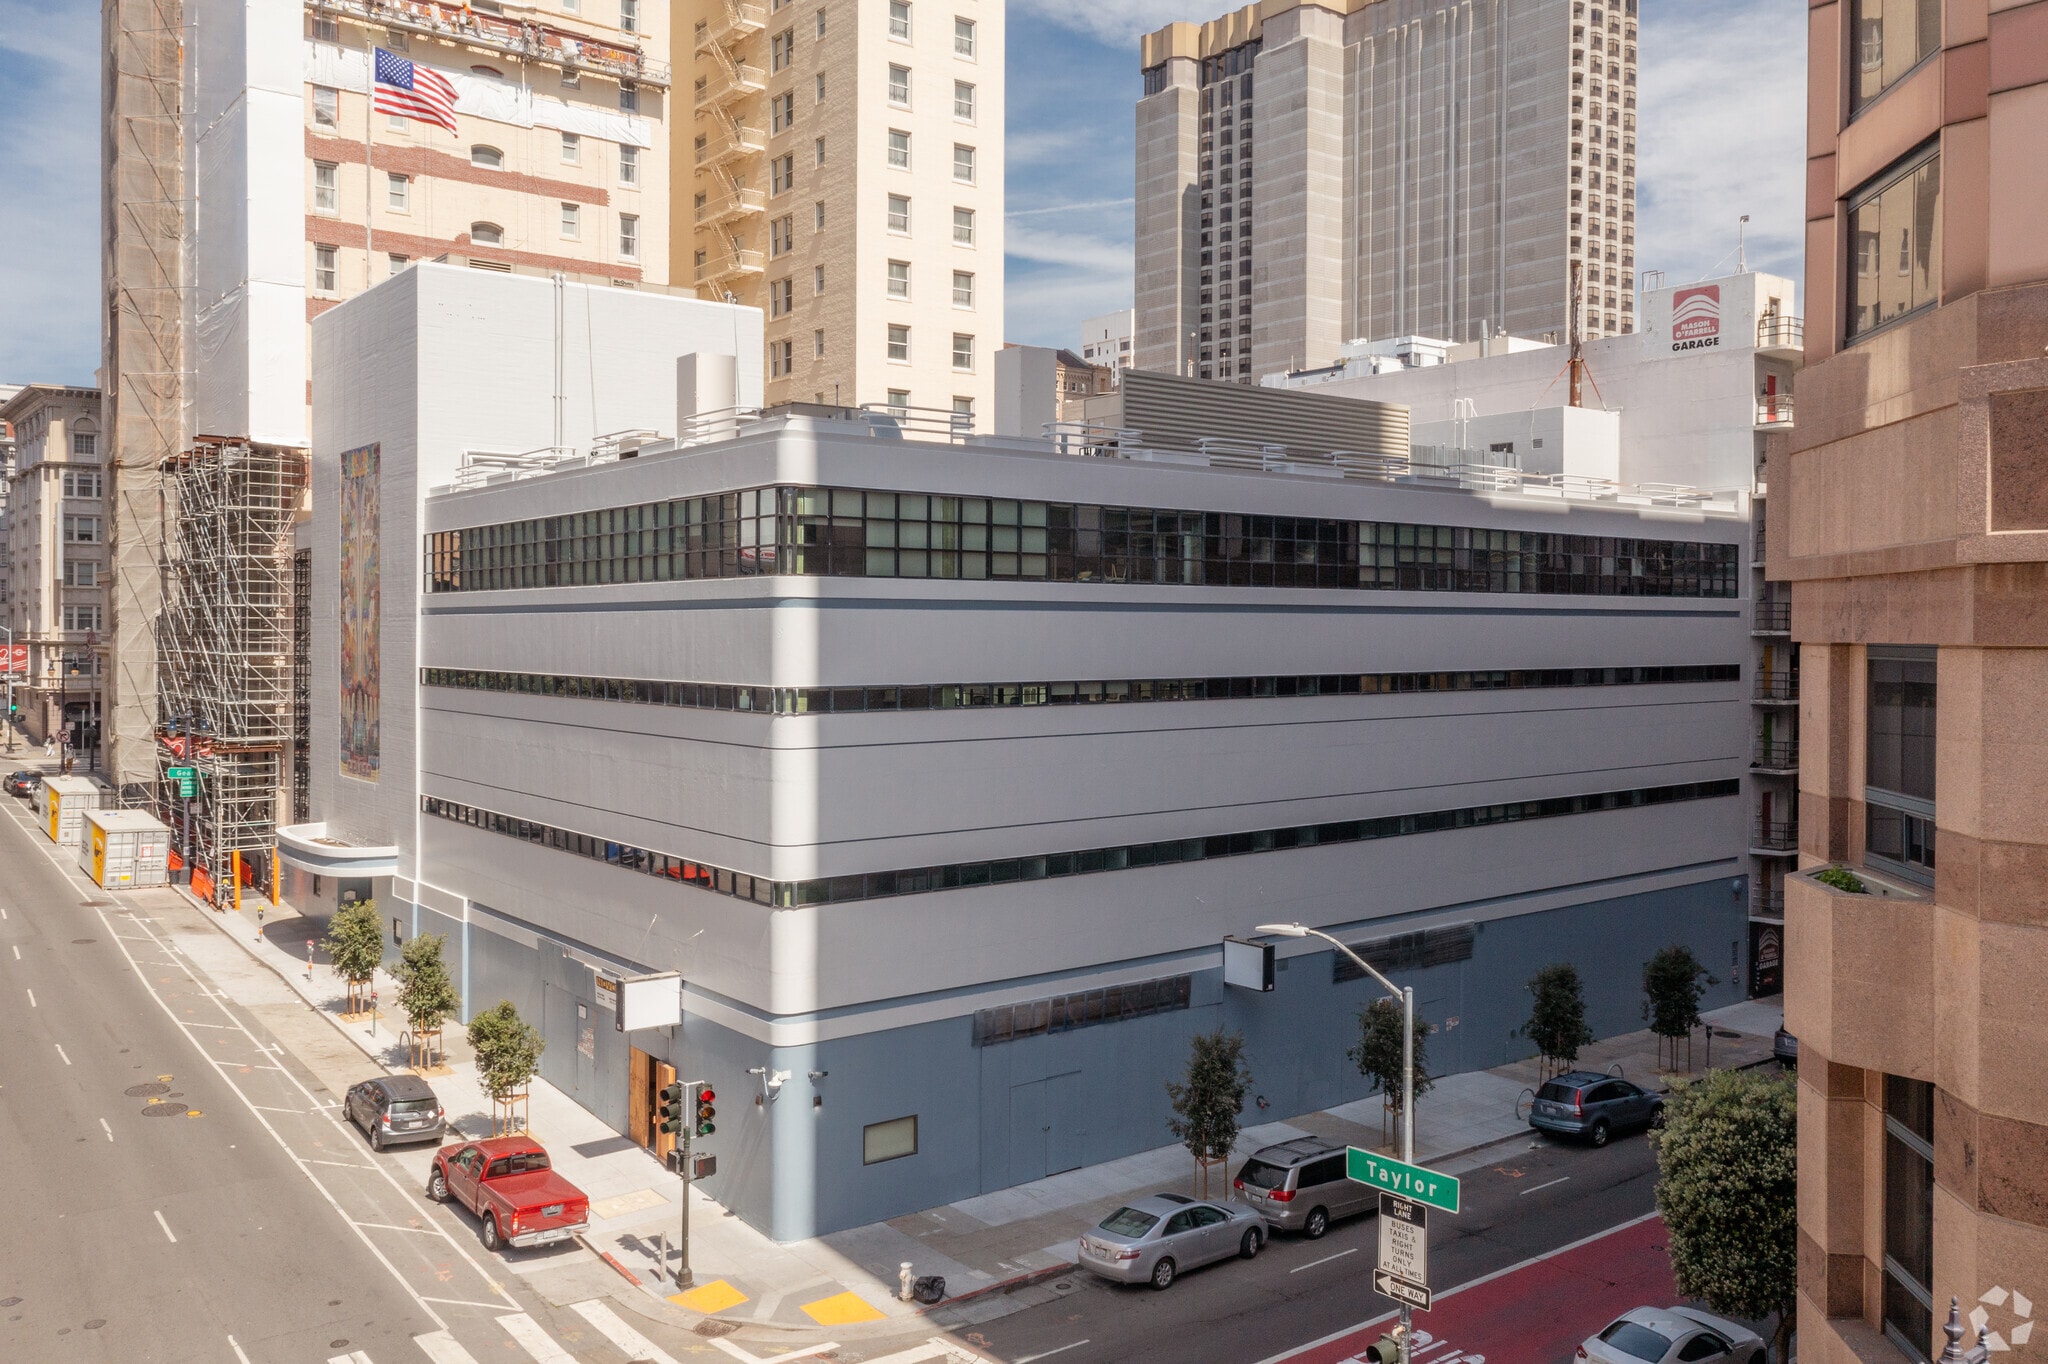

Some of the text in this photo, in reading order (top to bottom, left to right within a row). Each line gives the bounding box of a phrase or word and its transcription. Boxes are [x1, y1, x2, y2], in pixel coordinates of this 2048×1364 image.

[1681, 320, 1710, 330] MASON
[1675, 326, 1716, 338] O'FARRELL
[1672, 337, 1719, 351] GARAGE
[1366, 1160, 1437, 1197] Taylor
[1393, 1200, 1412, 1213] RIGHT
[1394, 1208, 1411, 1220] LANE
[1391, 1220, 1415, 1234] BUSES
[1389, 1228, 1408, 1240] TAXIS
[1391, 1238, 1412, 1251] RIGHT
[1391, 1246, 1415, 1260] TURNS
[1392, 1255, 1412, 1267] ONLY
[1383, 1261, 1422, 1281] AT ALL TIMES
[1390, 1282, 1424, 1302] ONE WAY
